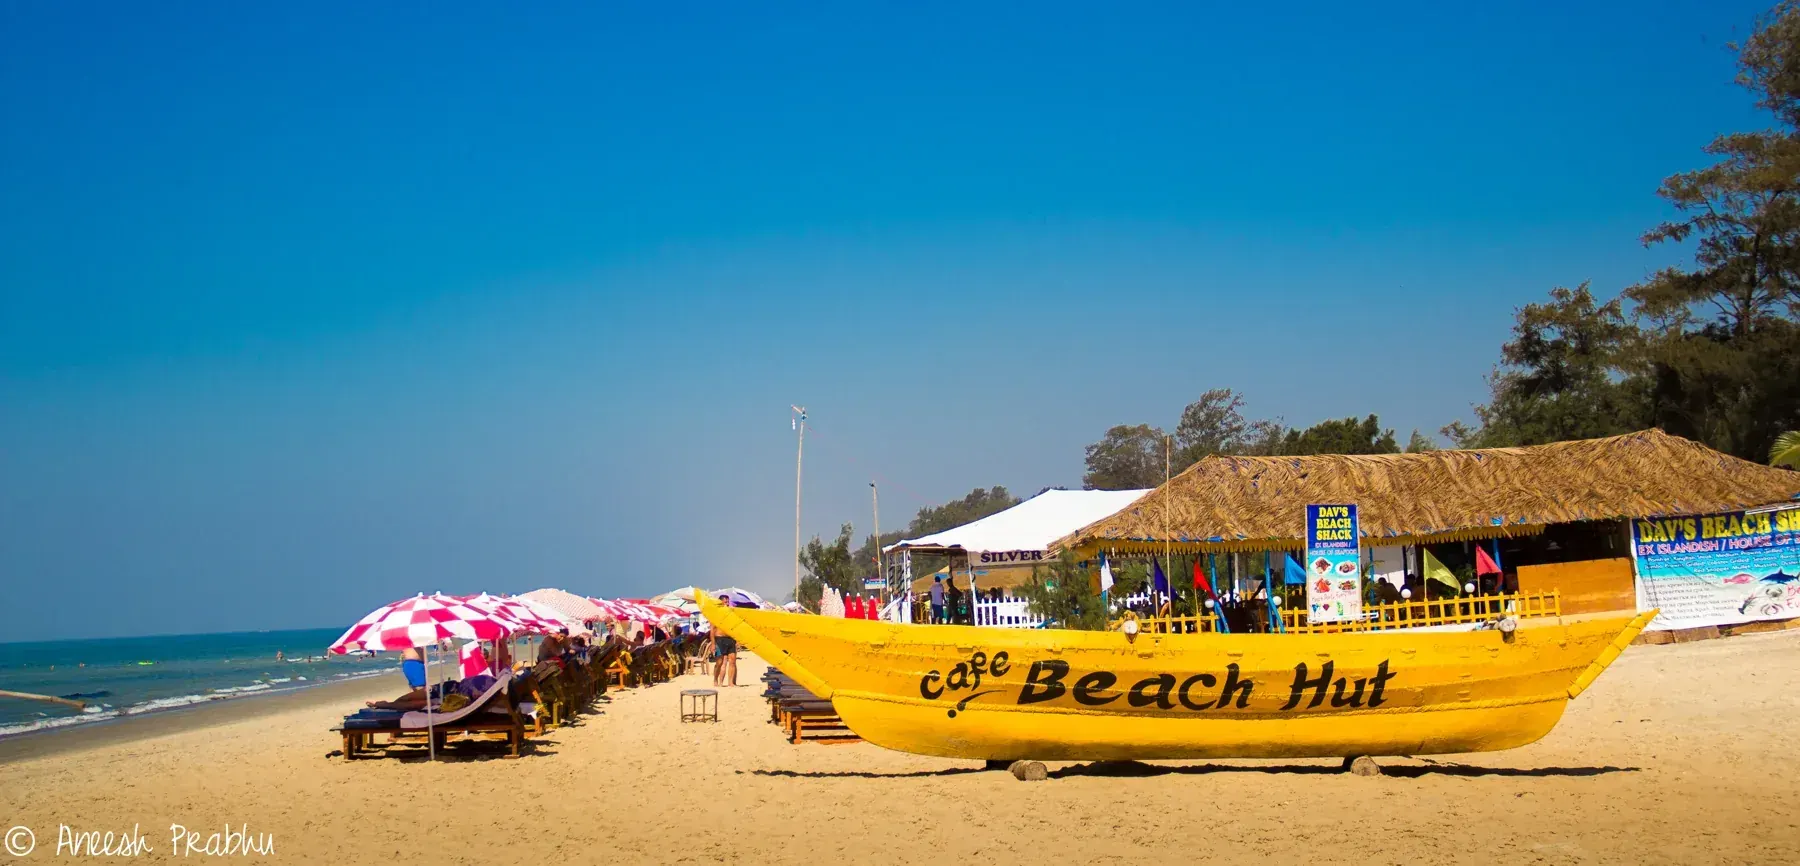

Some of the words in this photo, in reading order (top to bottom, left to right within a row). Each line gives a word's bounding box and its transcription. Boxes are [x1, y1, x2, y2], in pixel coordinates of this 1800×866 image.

[1319, 507, 1348, 517] DAV'S
[1316, 518, 1351, 529] BEACH
[1638, 519, 1696, 542] DAV'S
[1701, 513, 1772, 538] BEACH
[1316, 530, 1352, 540] SHACK
[1638, 544, 1655, 555] EX
[1657, 540, 1719, 554] ISLANDISH
[1729, 535, 1772, 549] HOUSE
[1775, 533, 1791, 545] OF
[981, 551, 1043, 563] SILVER
[920, 651, 1011, 700] cafe
[1017, 659, 1253, 710] Beach
[1278, 658, 1397, 711] Hut
